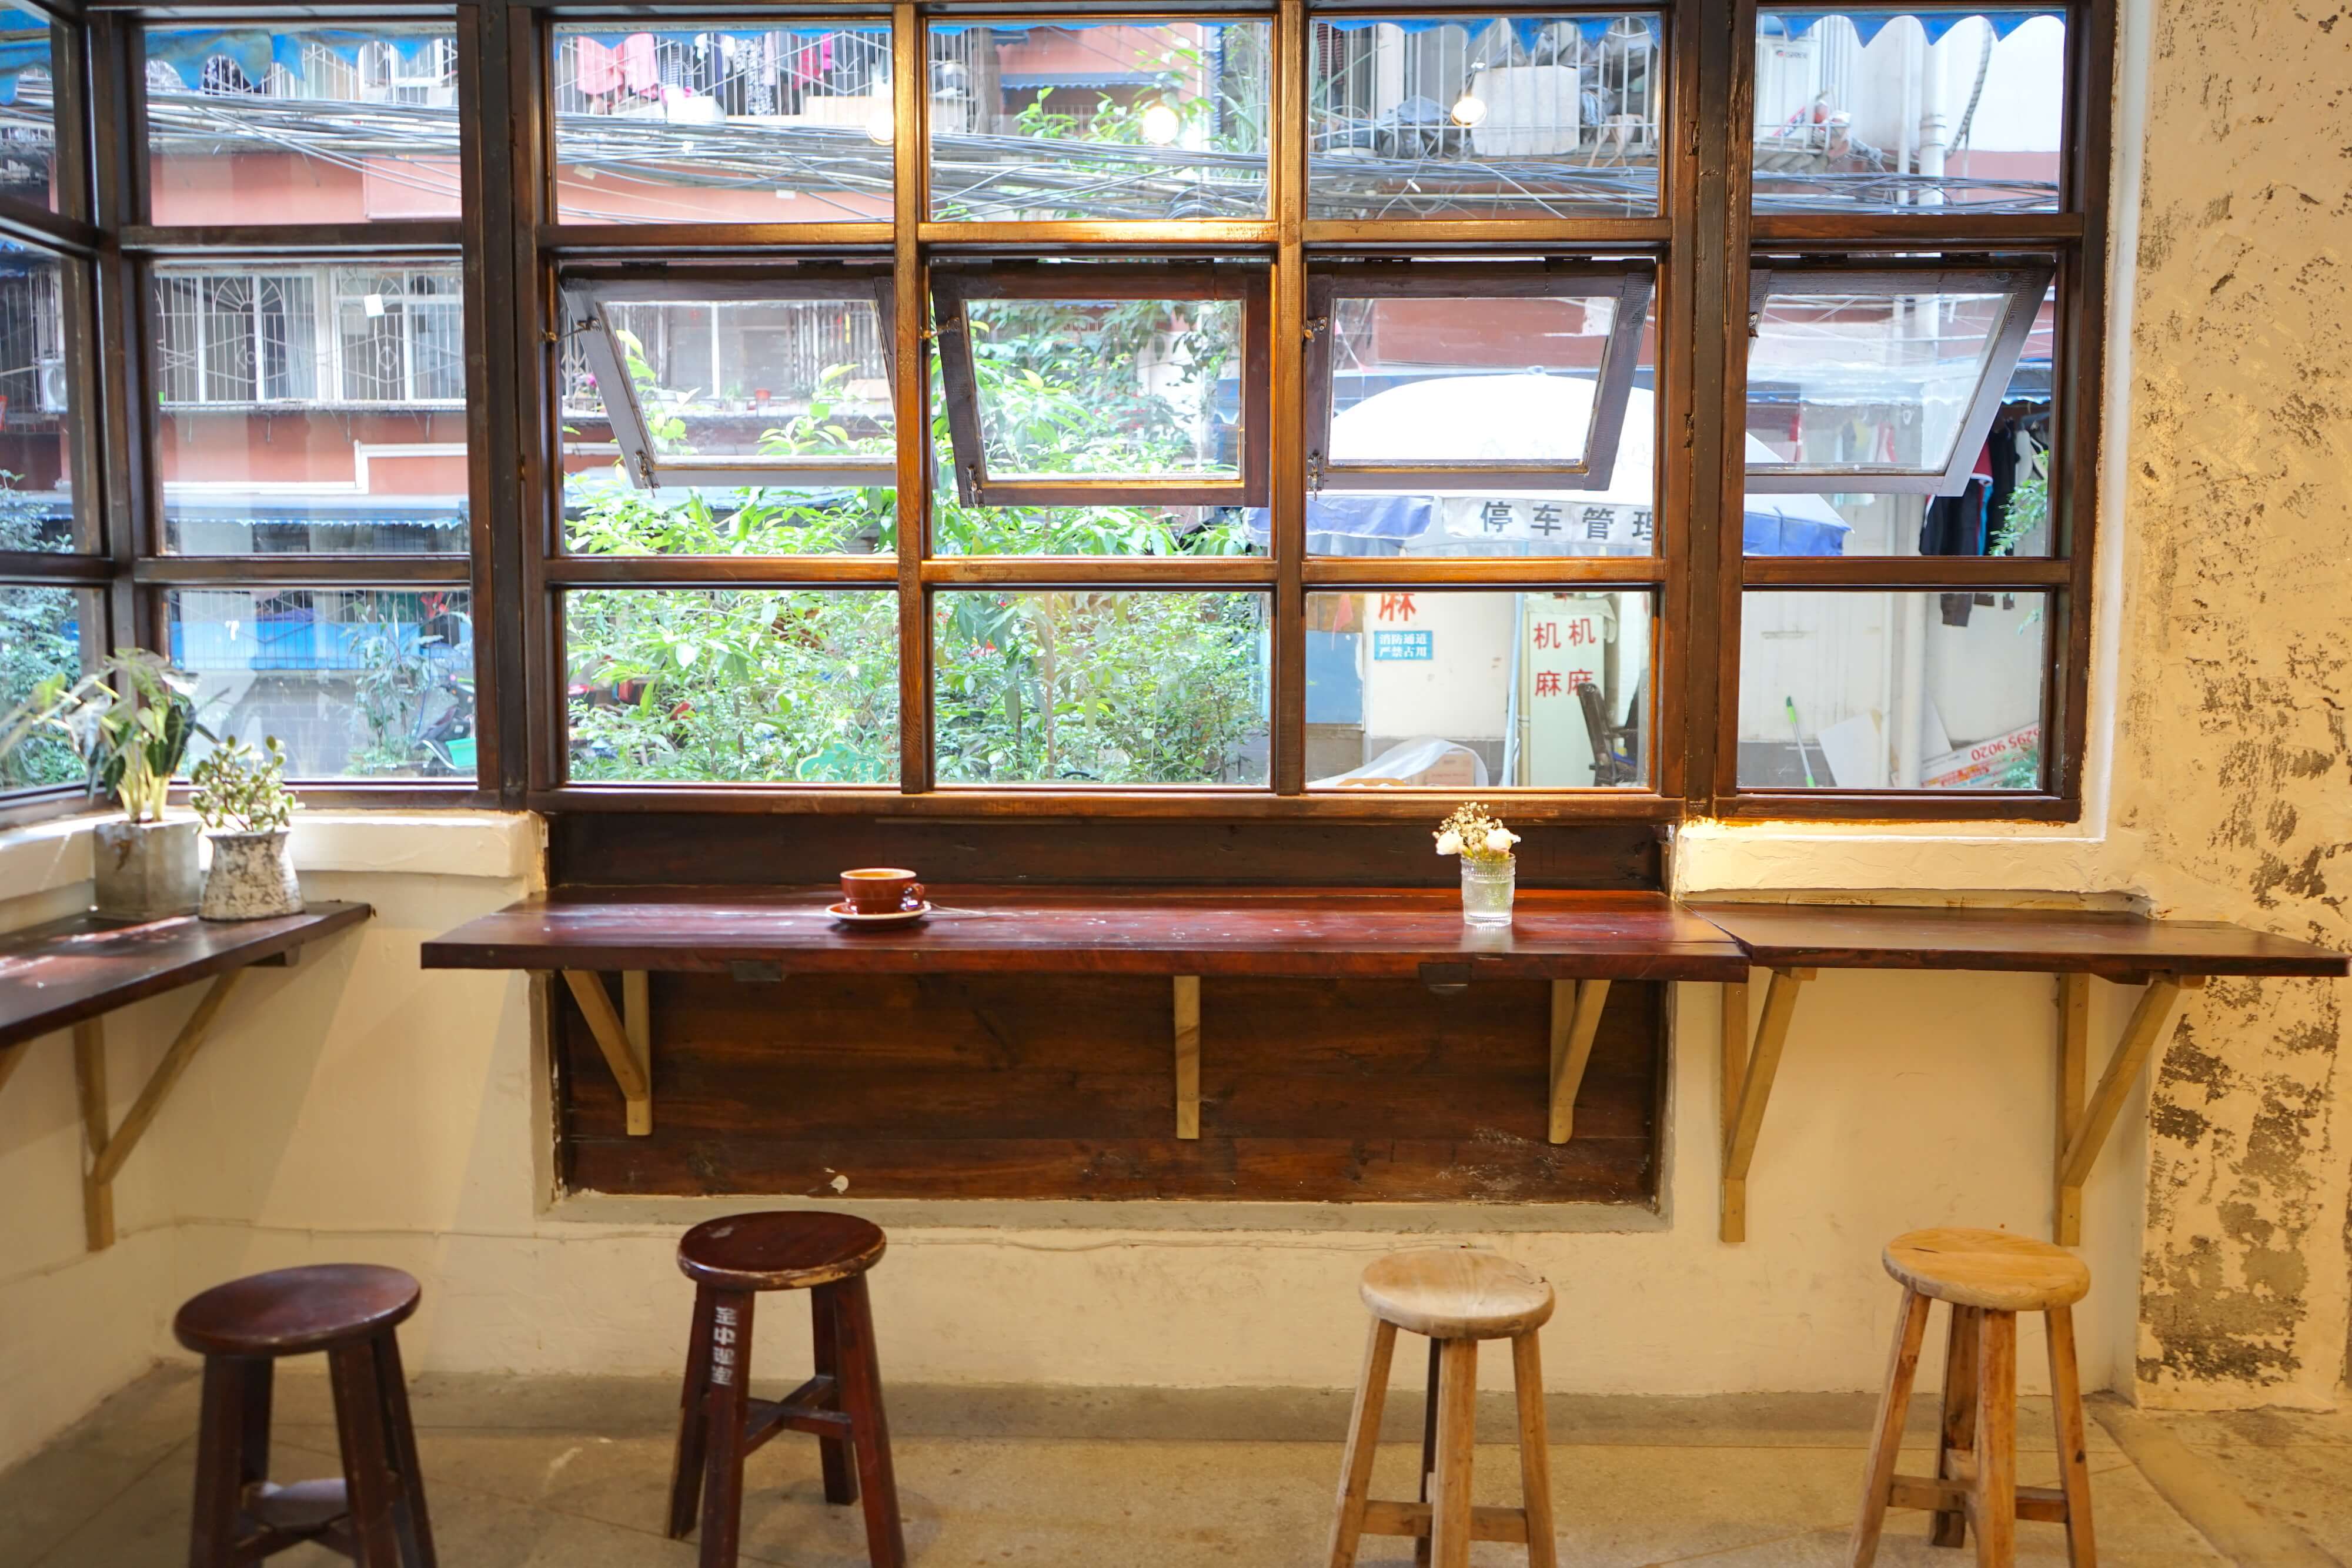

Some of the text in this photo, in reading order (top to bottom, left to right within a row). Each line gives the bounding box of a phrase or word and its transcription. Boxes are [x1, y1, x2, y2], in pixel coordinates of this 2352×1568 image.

[1480, 501, 1652, 540] 停车管理
[1379, 633, 1428, 645] 消防通道
